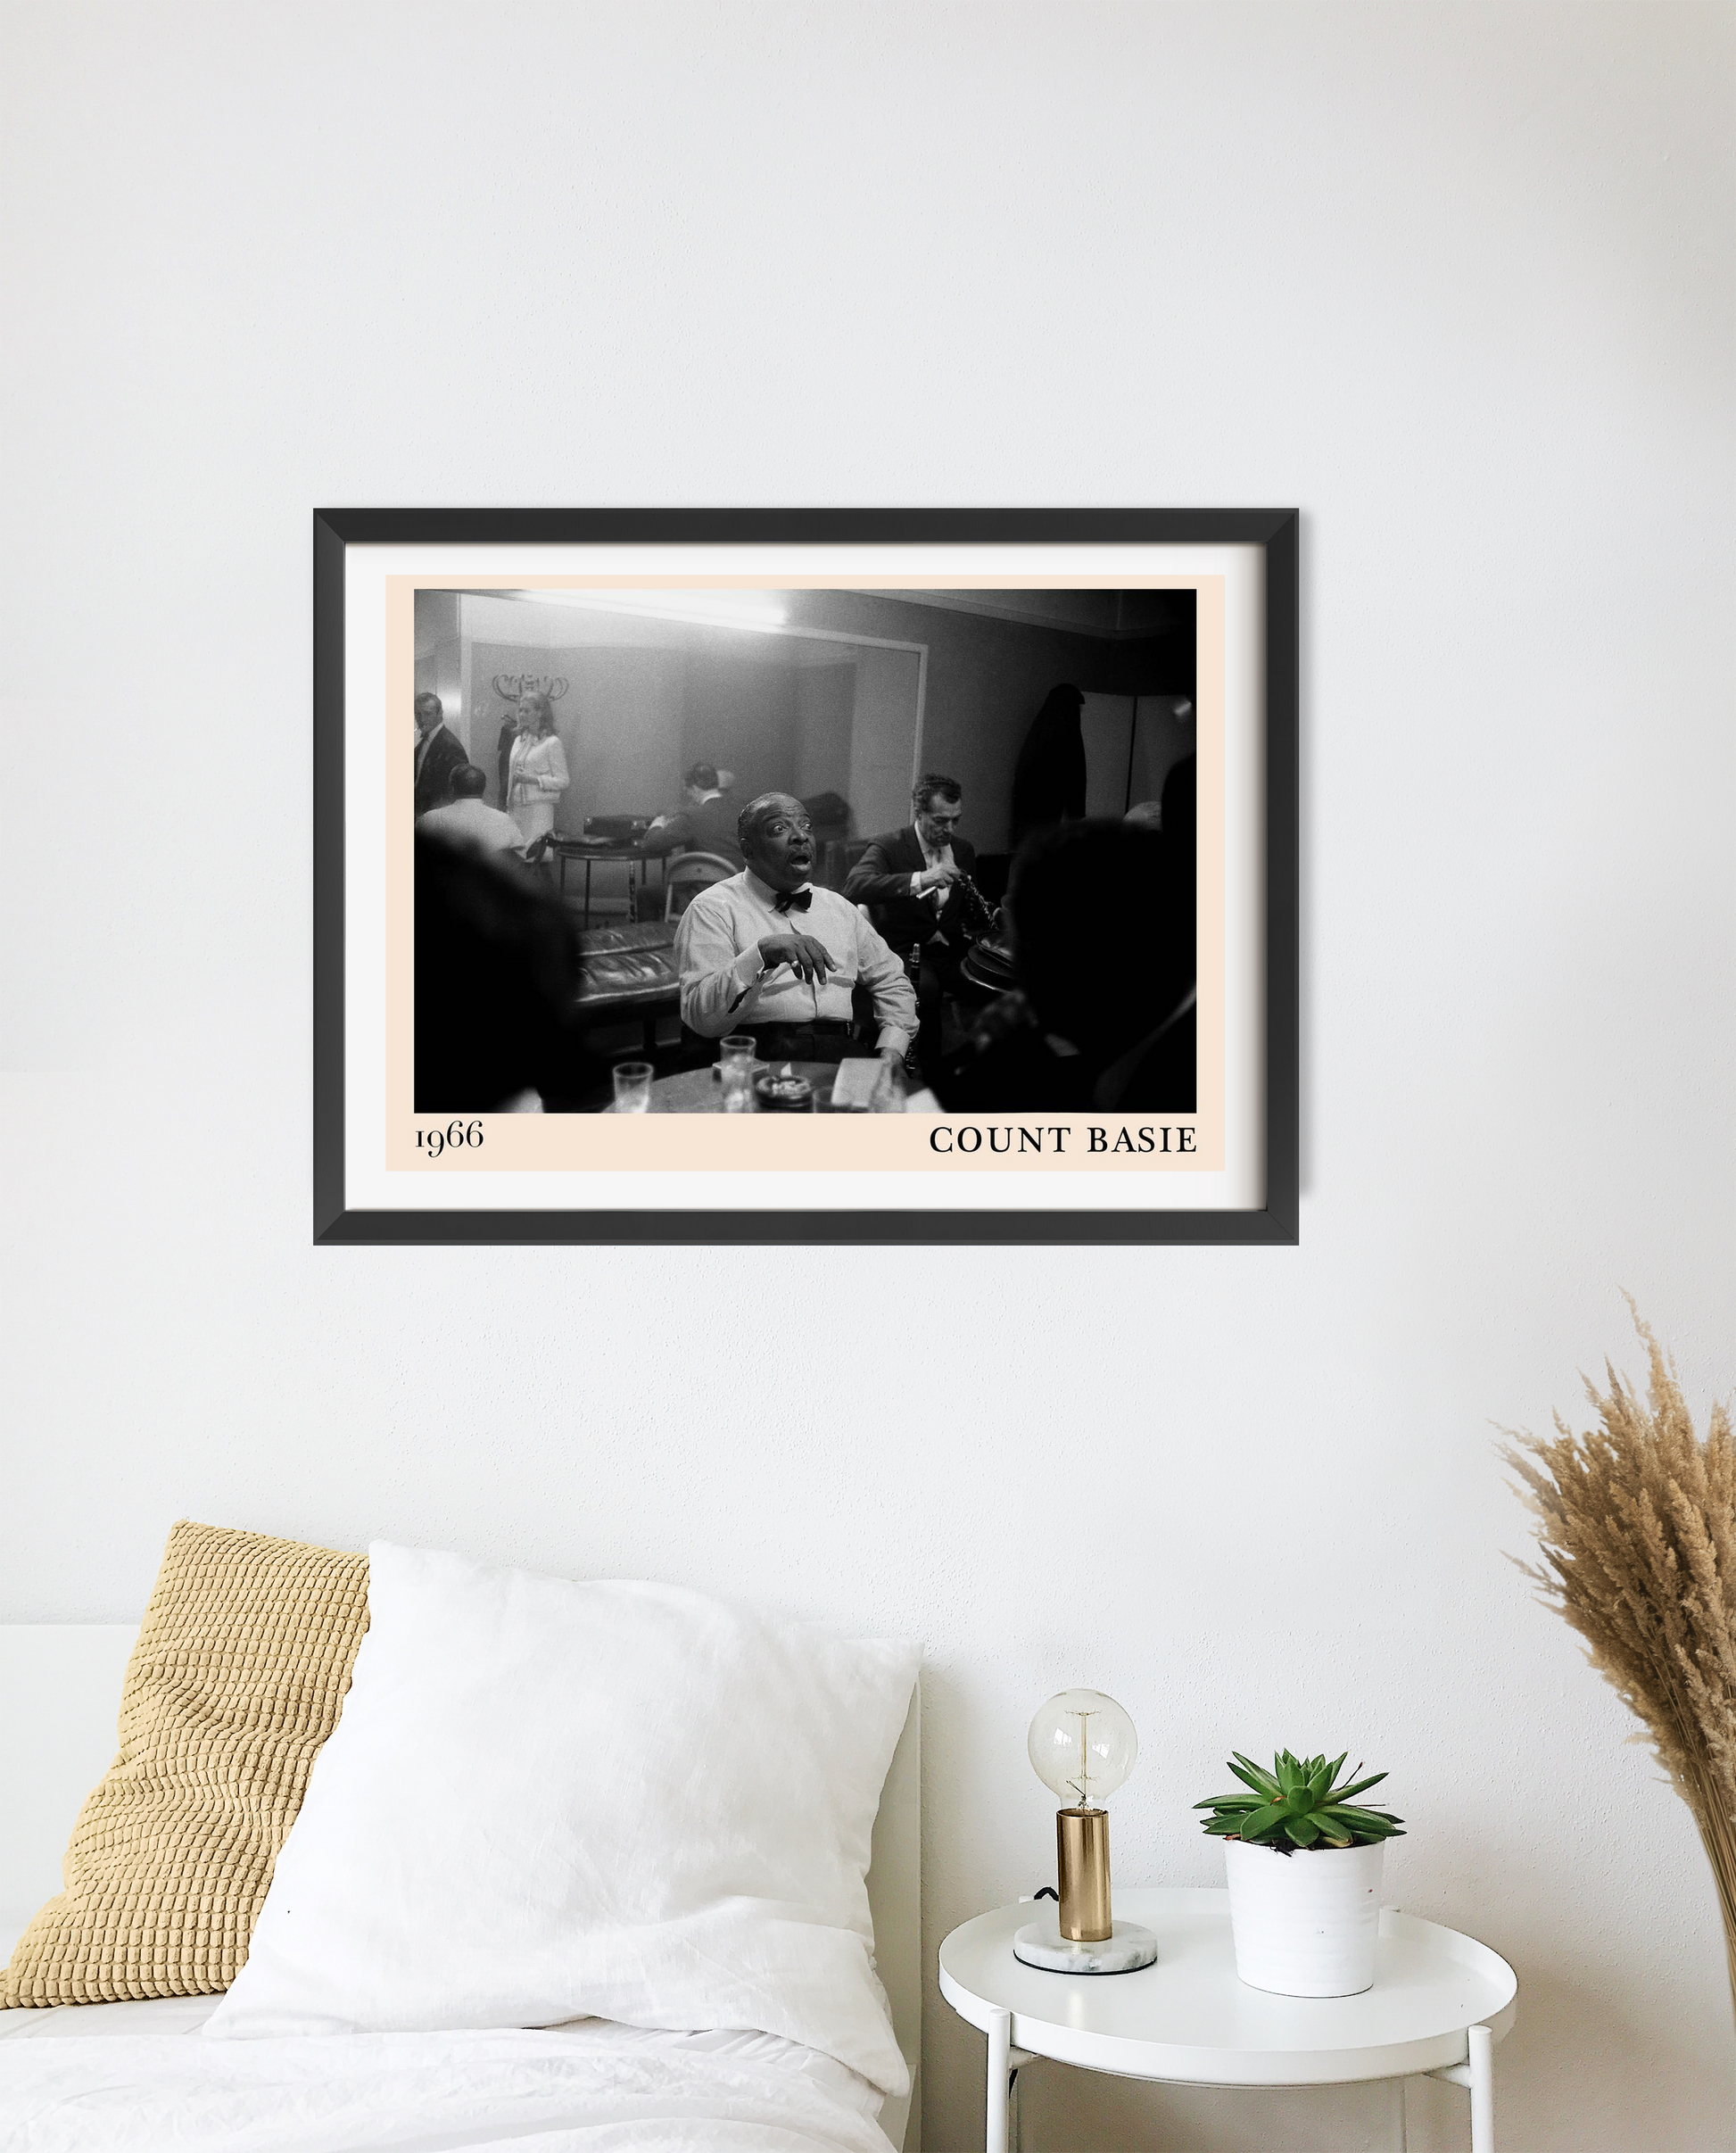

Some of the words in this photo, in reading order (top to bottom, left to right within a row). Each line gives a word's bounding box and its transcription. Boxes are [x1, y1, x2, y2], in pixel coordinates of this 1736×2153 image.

[416, 1120, 484, 1158] 1966
[930, 1126, 1071, 1153] COUNT
[1087, 1126, 1198, 1153] BASIE
